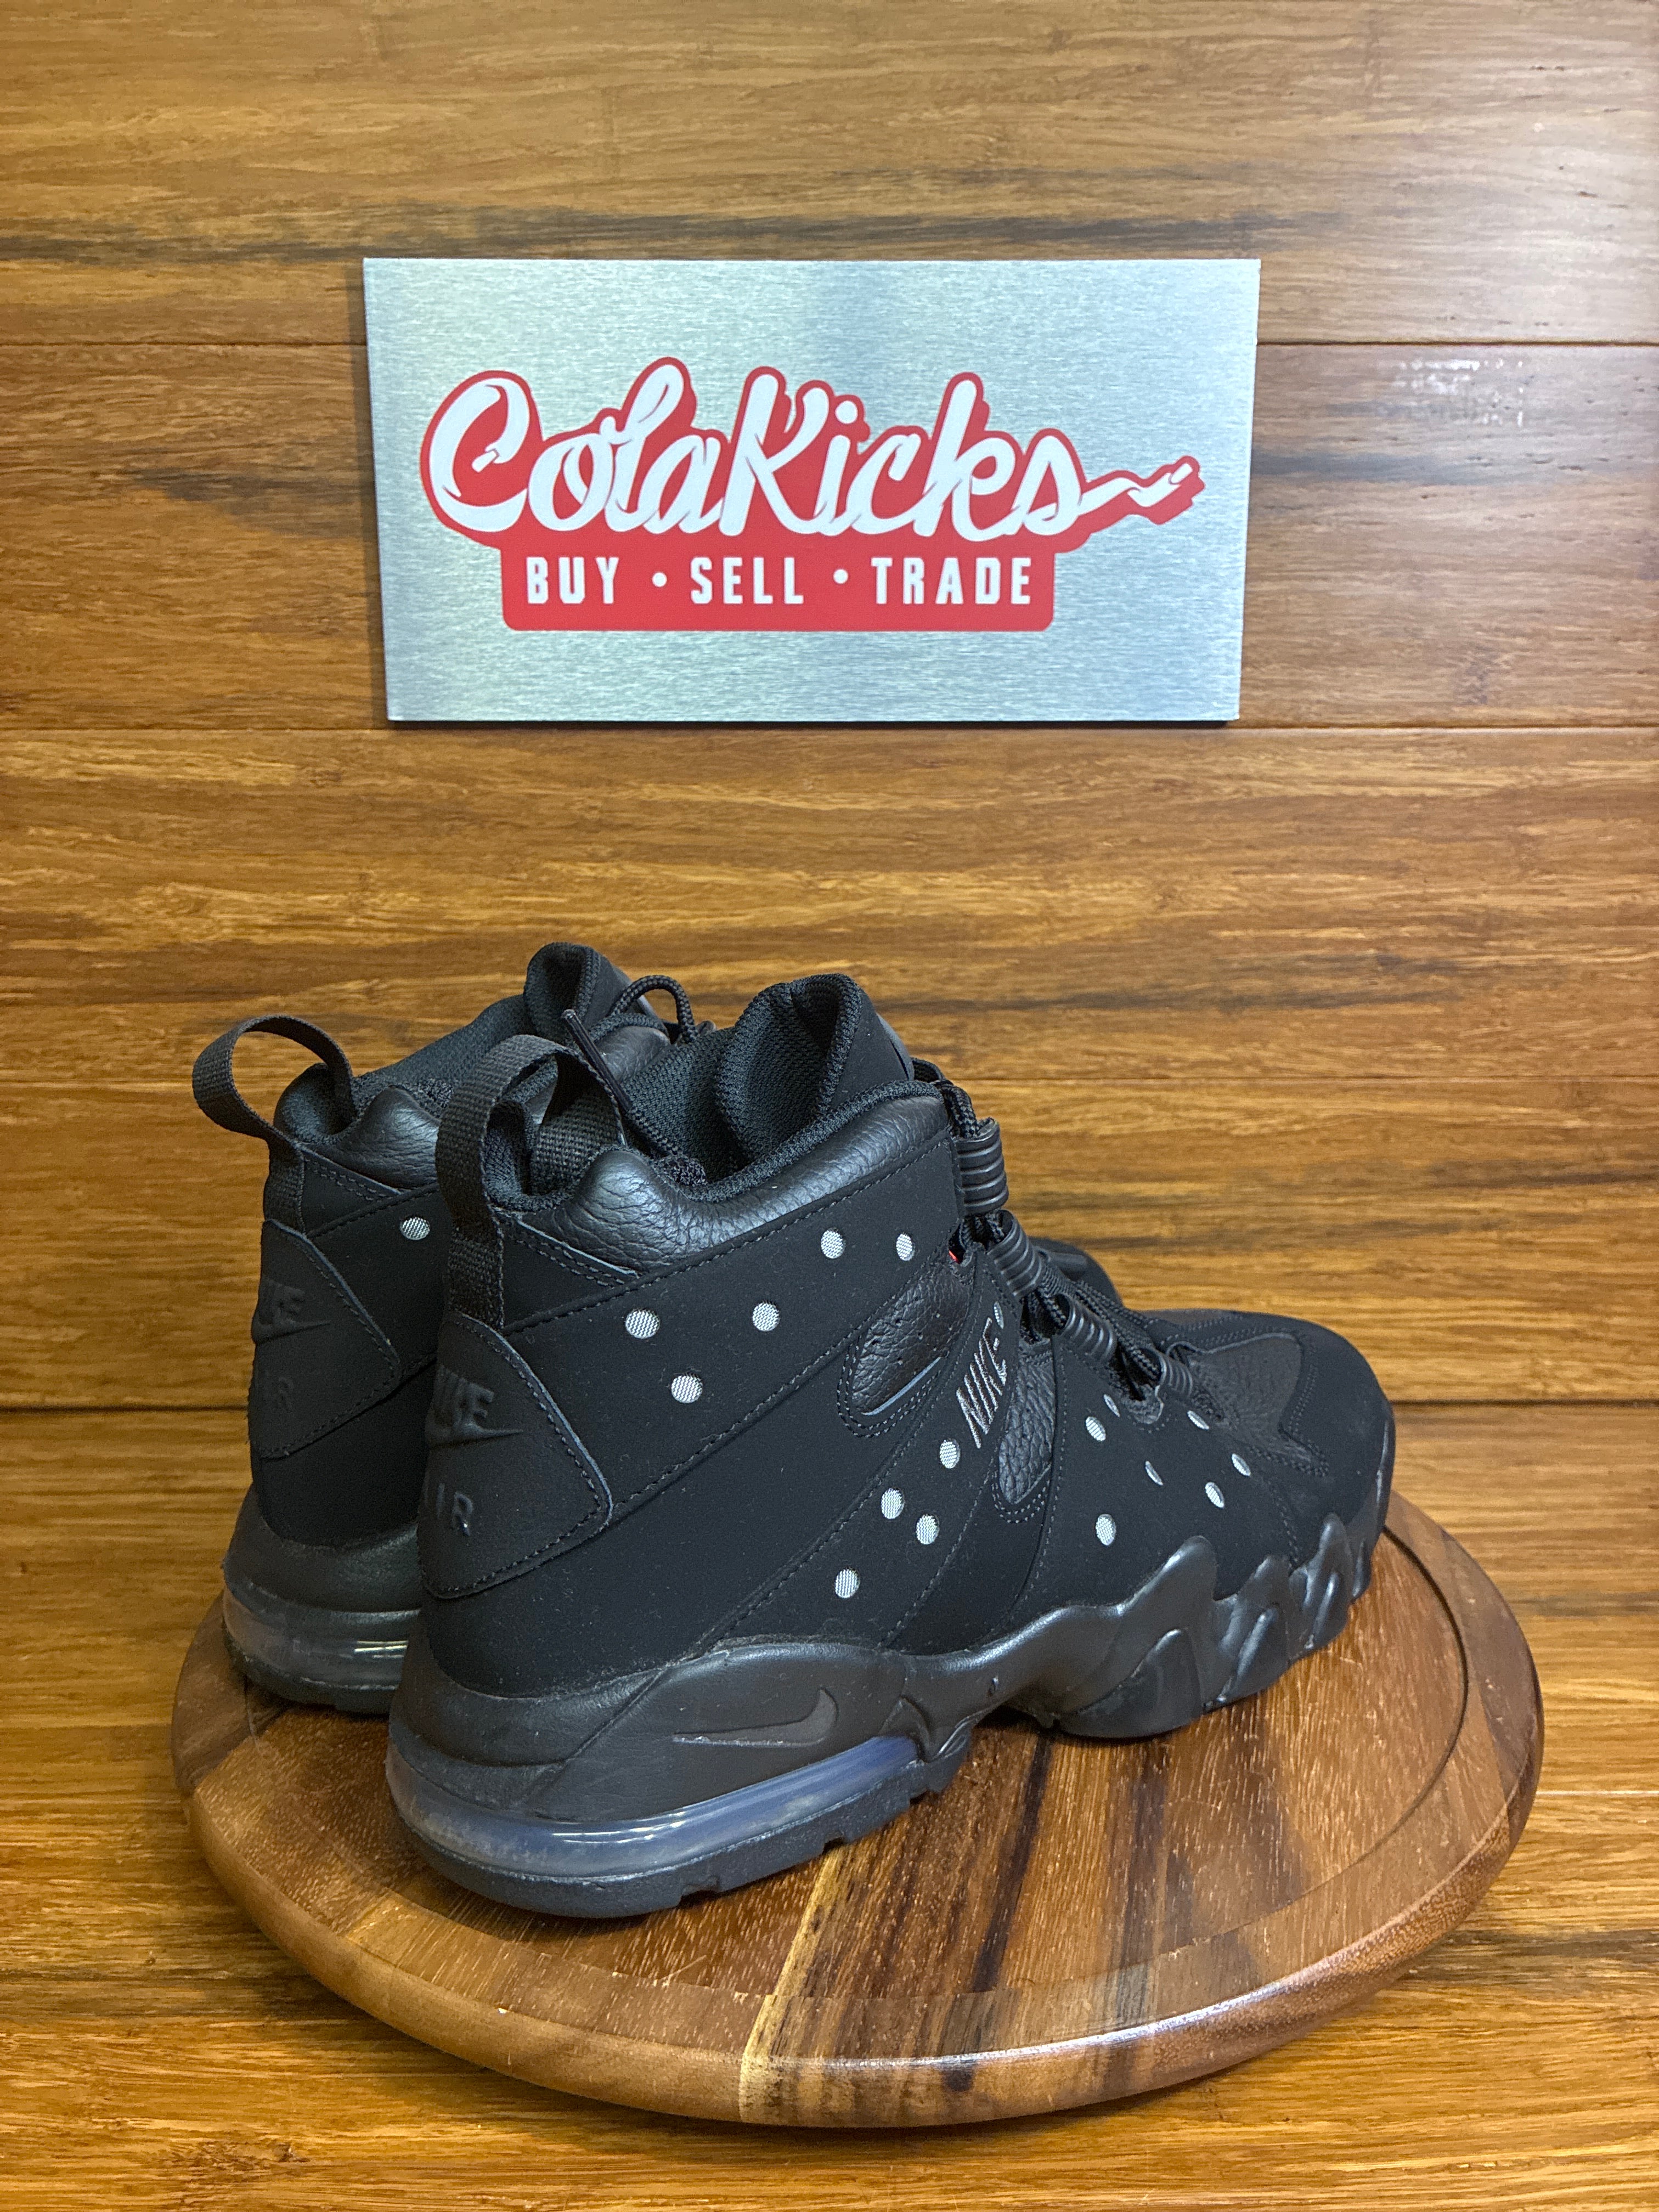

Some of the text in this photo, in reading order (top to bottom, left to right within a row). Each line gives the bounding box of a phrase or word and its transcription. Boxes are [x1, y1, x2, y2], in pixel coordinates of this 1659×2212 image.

[429, 364, 1192, 541] ColaKicks
[527, 557, 1031, 604] BUY SELL TRADE
